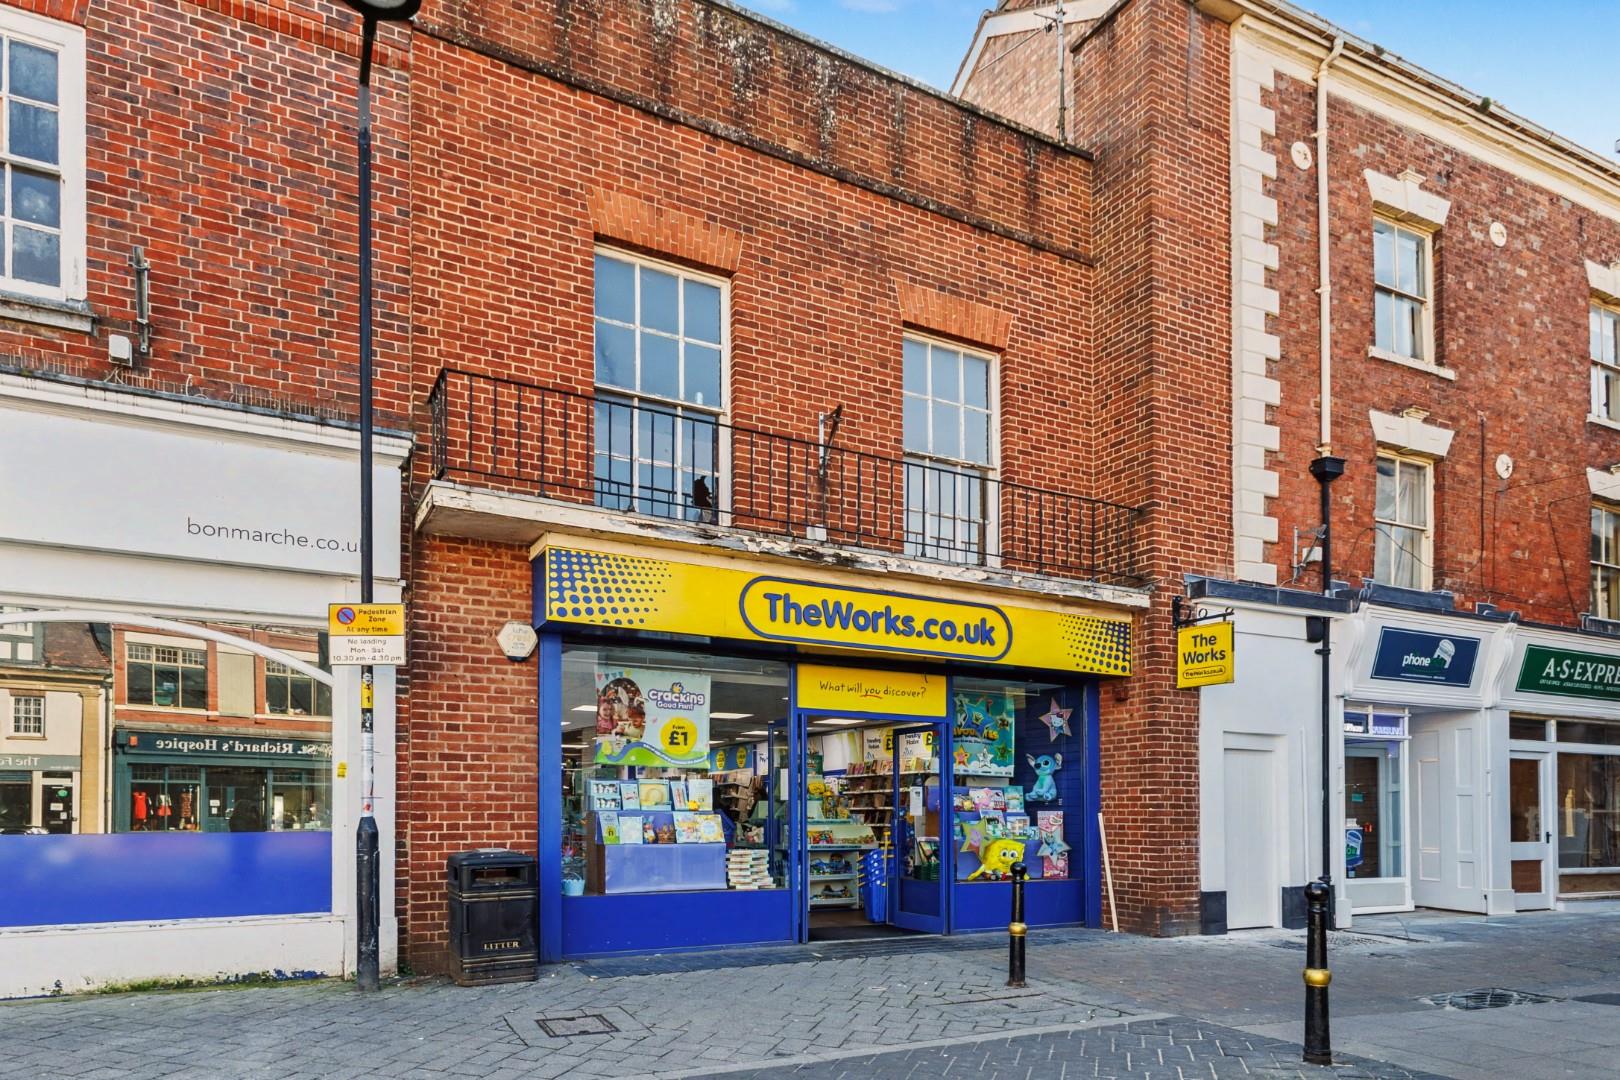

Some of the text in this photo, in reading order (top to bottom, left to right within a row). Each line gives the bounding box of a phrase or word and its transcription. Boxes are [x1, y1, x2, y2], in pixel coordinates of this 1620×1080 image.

[187, 516, 361, 554] bonmarche.co.u
[763, 592, 996, 646] TheWorks.co.uk
[1191, 633, 1217, 648] The
[1183, 648, 1226, 665] Works
[1402, 652, 1431, 667] phone
[819, 680, 927, 698] What will you discover?
[648, 689, 705, 706] Cracking
[657, 701, 677, 709] Good
[669, 730, 688, 746] £1
[484, 941, 519, 951] LITTER
